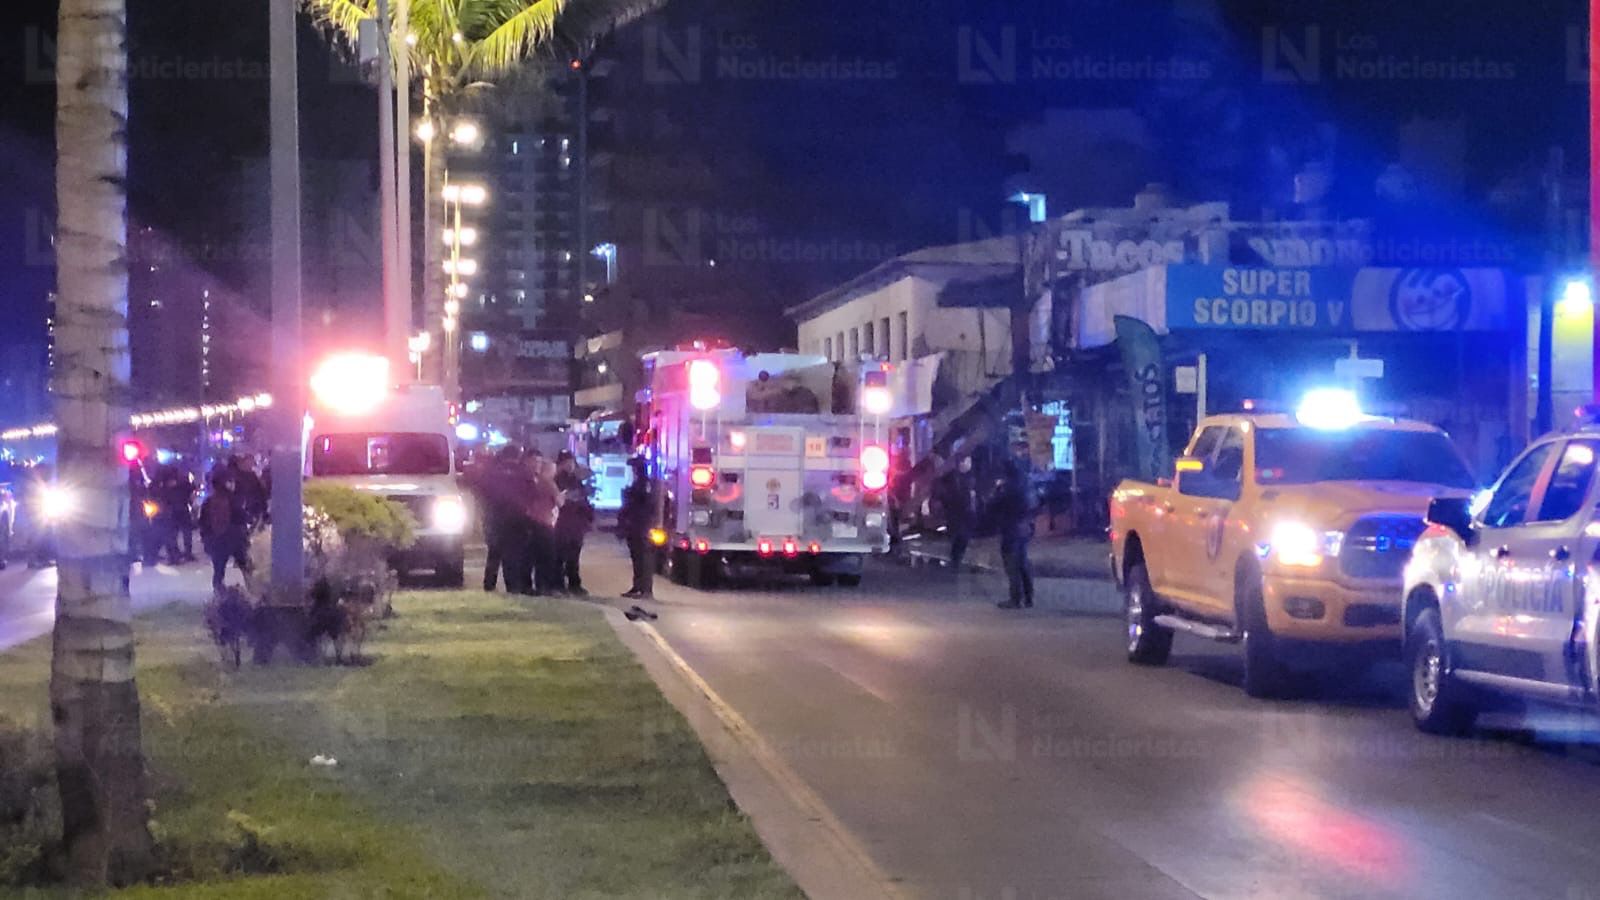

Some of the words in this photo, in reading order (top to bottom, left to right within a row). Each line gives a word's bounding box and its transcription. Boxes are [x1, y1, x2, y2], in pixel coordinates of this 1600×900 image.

[1223, 267, 1312, 297] SUPER
[1192, 297, 1318, 327] SCORPIO
[1326, 300, 1345, 327] V
